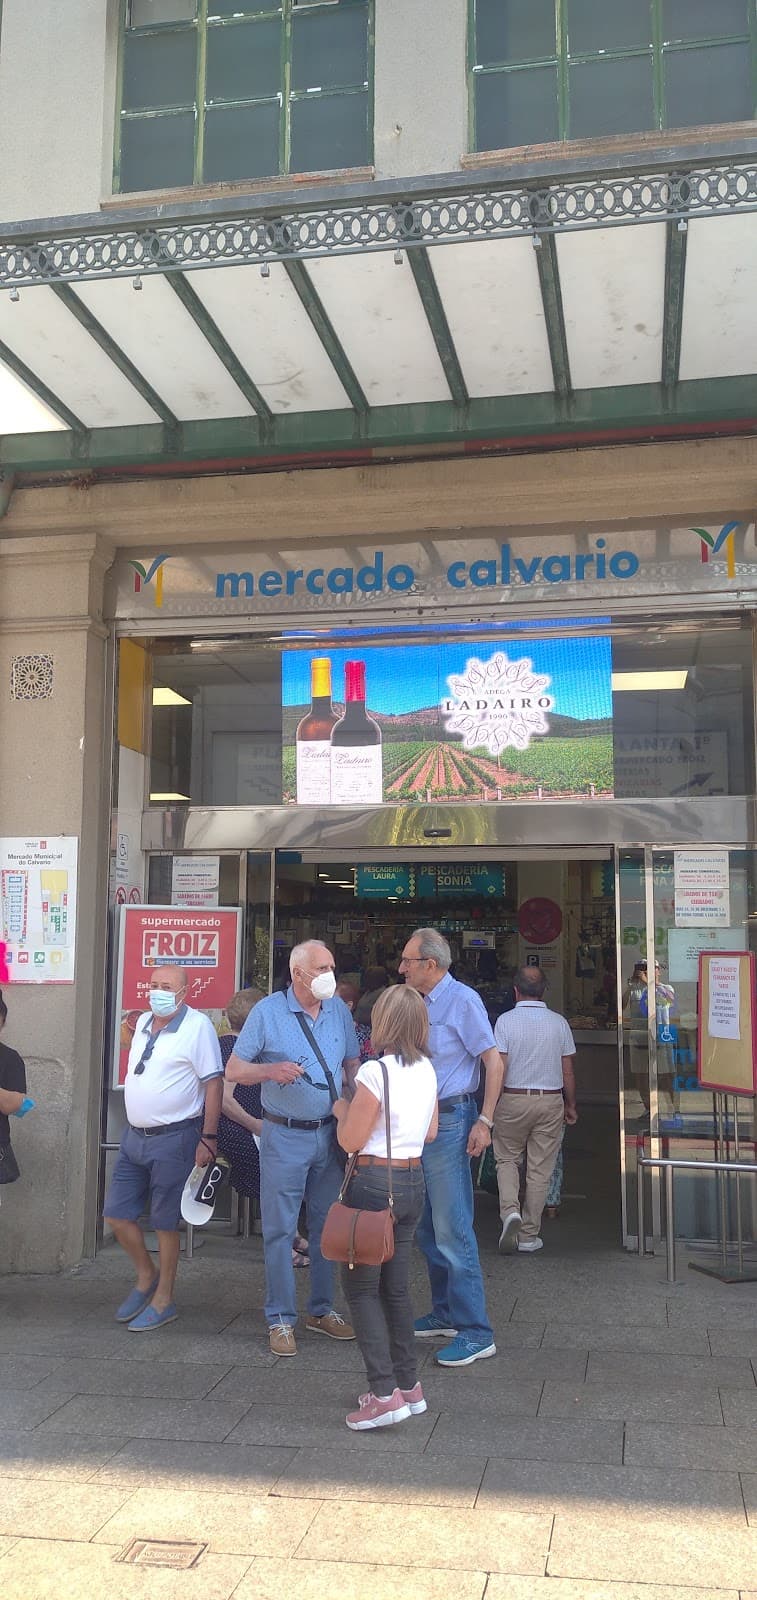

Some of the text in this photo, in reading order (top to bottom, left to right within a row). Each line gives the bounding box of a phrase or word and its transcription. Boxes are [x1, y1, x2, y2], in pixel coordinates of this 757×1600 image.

[215, 539, 640, 598] mercado calvario
[446, 697, 551, 711] LADAIRO
[437, 876, 472, 886] SONIA
[141, 917, 221, 927] supermercado
[144, 932, 217, 957] FROIZ
